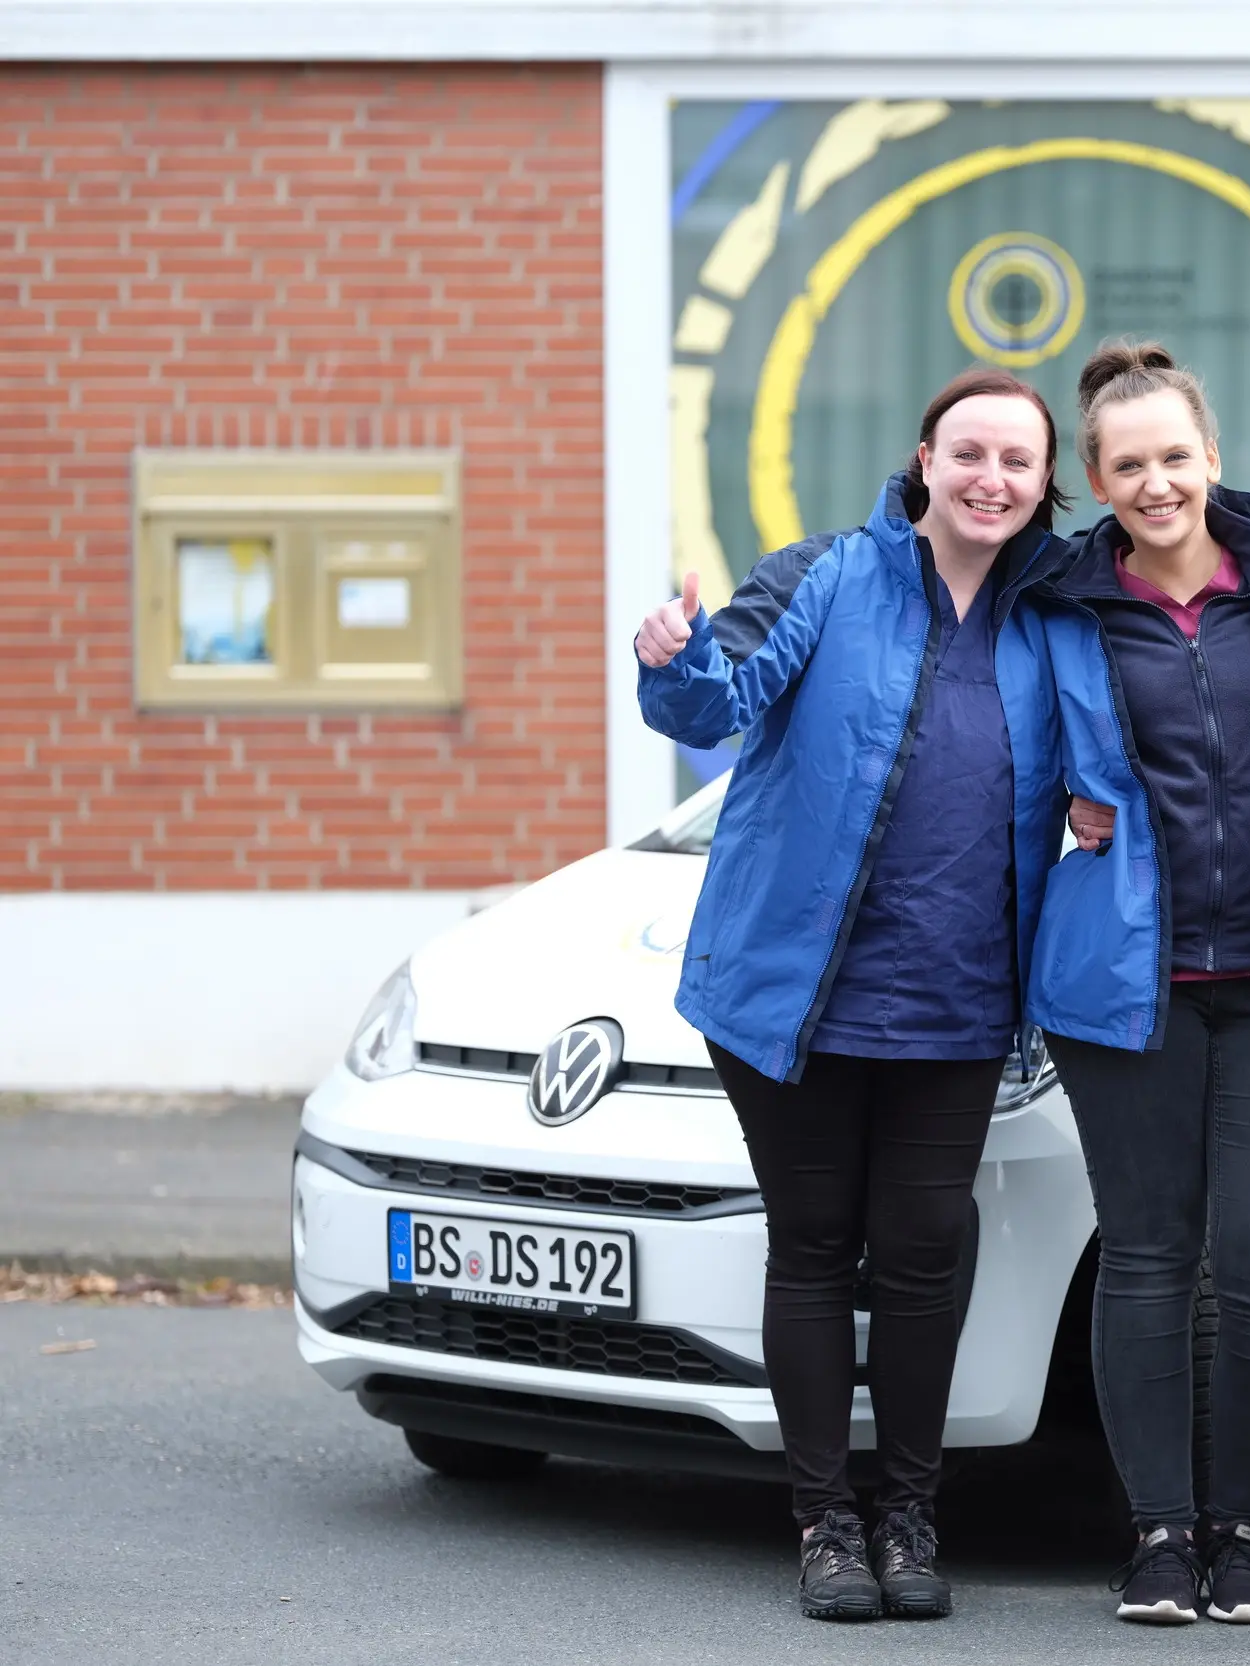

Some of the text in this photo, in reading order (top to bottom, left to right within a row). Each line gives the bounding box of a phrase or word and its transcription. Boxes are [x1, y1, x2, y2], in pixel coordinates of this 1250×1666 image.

[397, 1253, 406, 1270] D
[413, 1222, 624, 1298] BS DS 192
[451, 1289, 559, 1312] WILLI-NIES.DE
